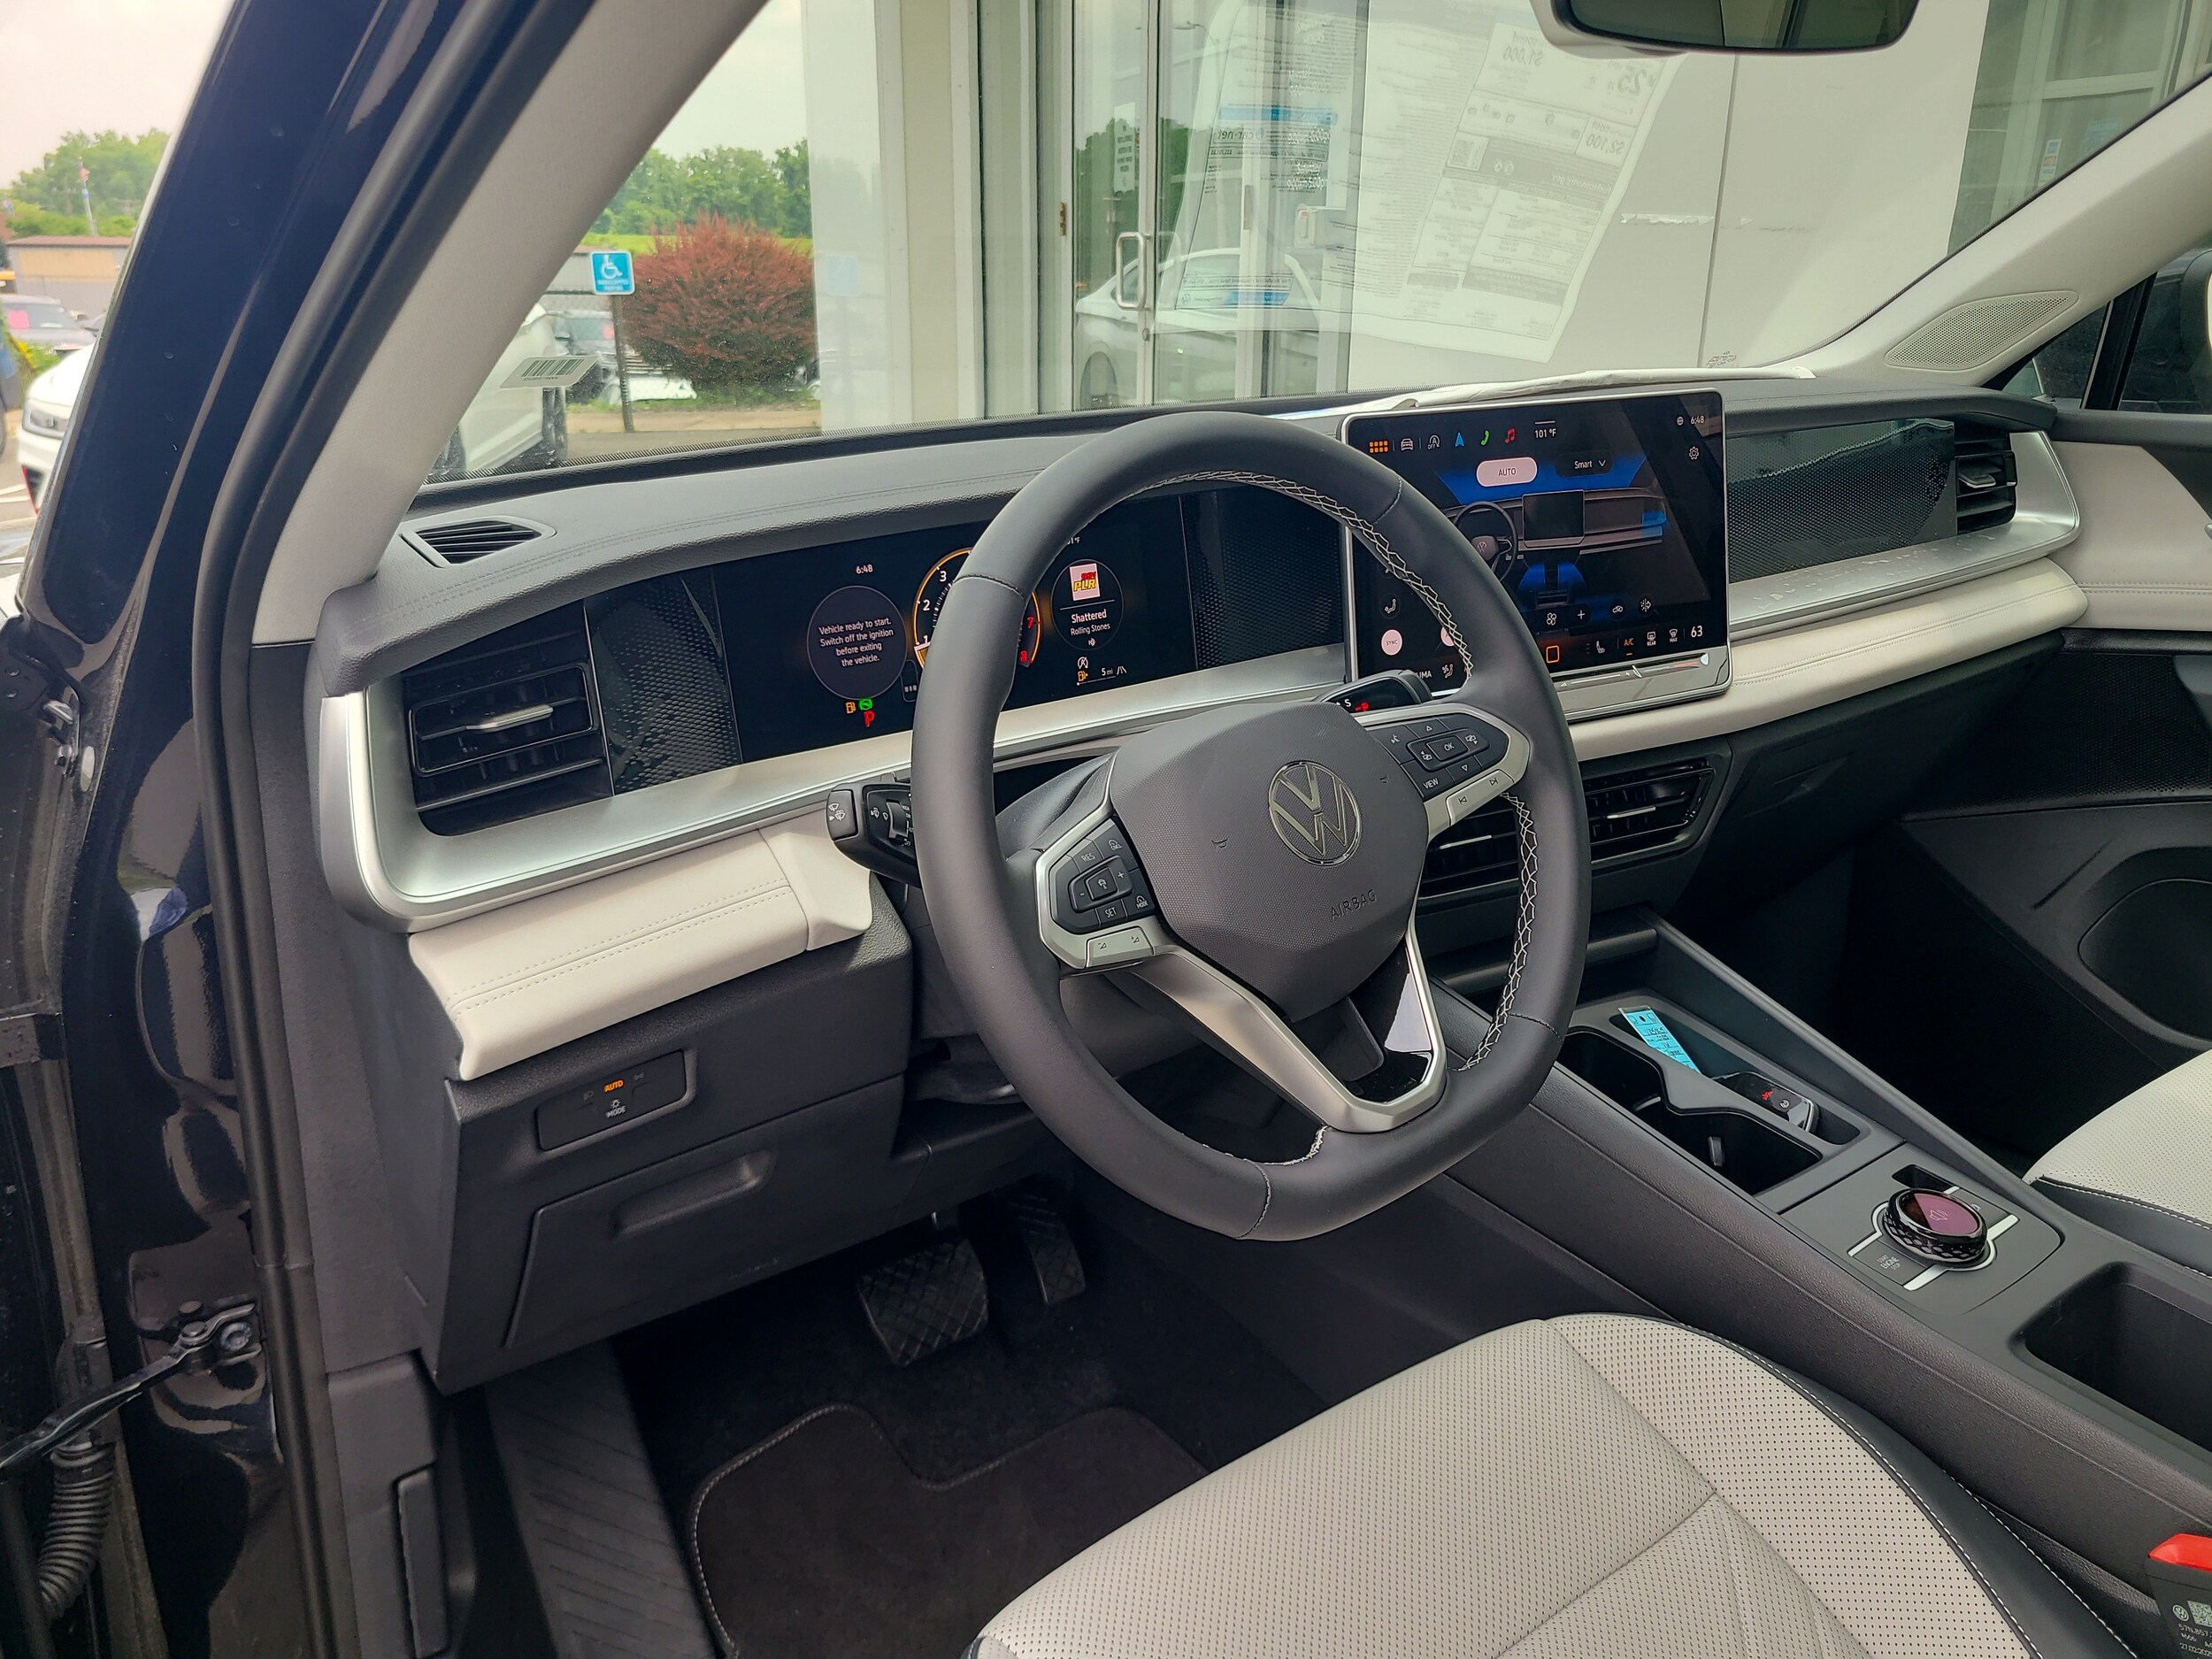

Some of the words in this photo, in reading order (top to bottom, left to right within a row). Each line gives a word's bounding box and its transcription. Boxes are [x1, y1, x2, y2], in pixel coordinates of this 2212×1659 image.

[1691, 415, 1705, 425] 6:48
[1534, 428, 1548, 439] 101
[1574, 460, 1593, 470] Smart
[1498, 467, 1517, 477] AUTO
[856, 565, 873, 574] 6:48
[939, 571, 947, 582] 3
[1073, 579, 1096, 592] PLR
[923, 599, 930, 611] 2
[1071, 608, 1107, 624] Shattered
[818, 624, 844, 634] Vehicle
[845, 621, 864, 631] ready
[874, 618, 891, 626] start.
[1026, 617, 1034, 629] 7
[1071, 626, 1091, 635] Rolling
[1091, 623, 1110, 632] Stones
[820, 636, 843, 647] Switch
[845, 634, 855, 642] off
[869, 629, 894, 641] ignition
[1691, 626, 1703, 638] 63
[836, 646, 858, 657] before
[860, 642, 882, 652] exiting
[841, 658, 854, 667] the
[855, 654, 880, 664] vehicle.
[1020, 650, 1028, 663] 8
[1101, 667, 1106, 676] 5
[1344, 698, 1352, 708] S
[864, 710, 875, 727] P
[1443, 741, 1455, 751] OK
[1422, 777, 1439, 789] VIEW
[1080, 852, 1096, 863] RES
[1136, 899, 1148, 910] MODE
[1330, 888, 1378, 921] AIRBAG
[1104, 907, 1117, 918] SET
[603, 1079, 624, 1093] AUTO
[605, 1106, 626, 1118] MODE
